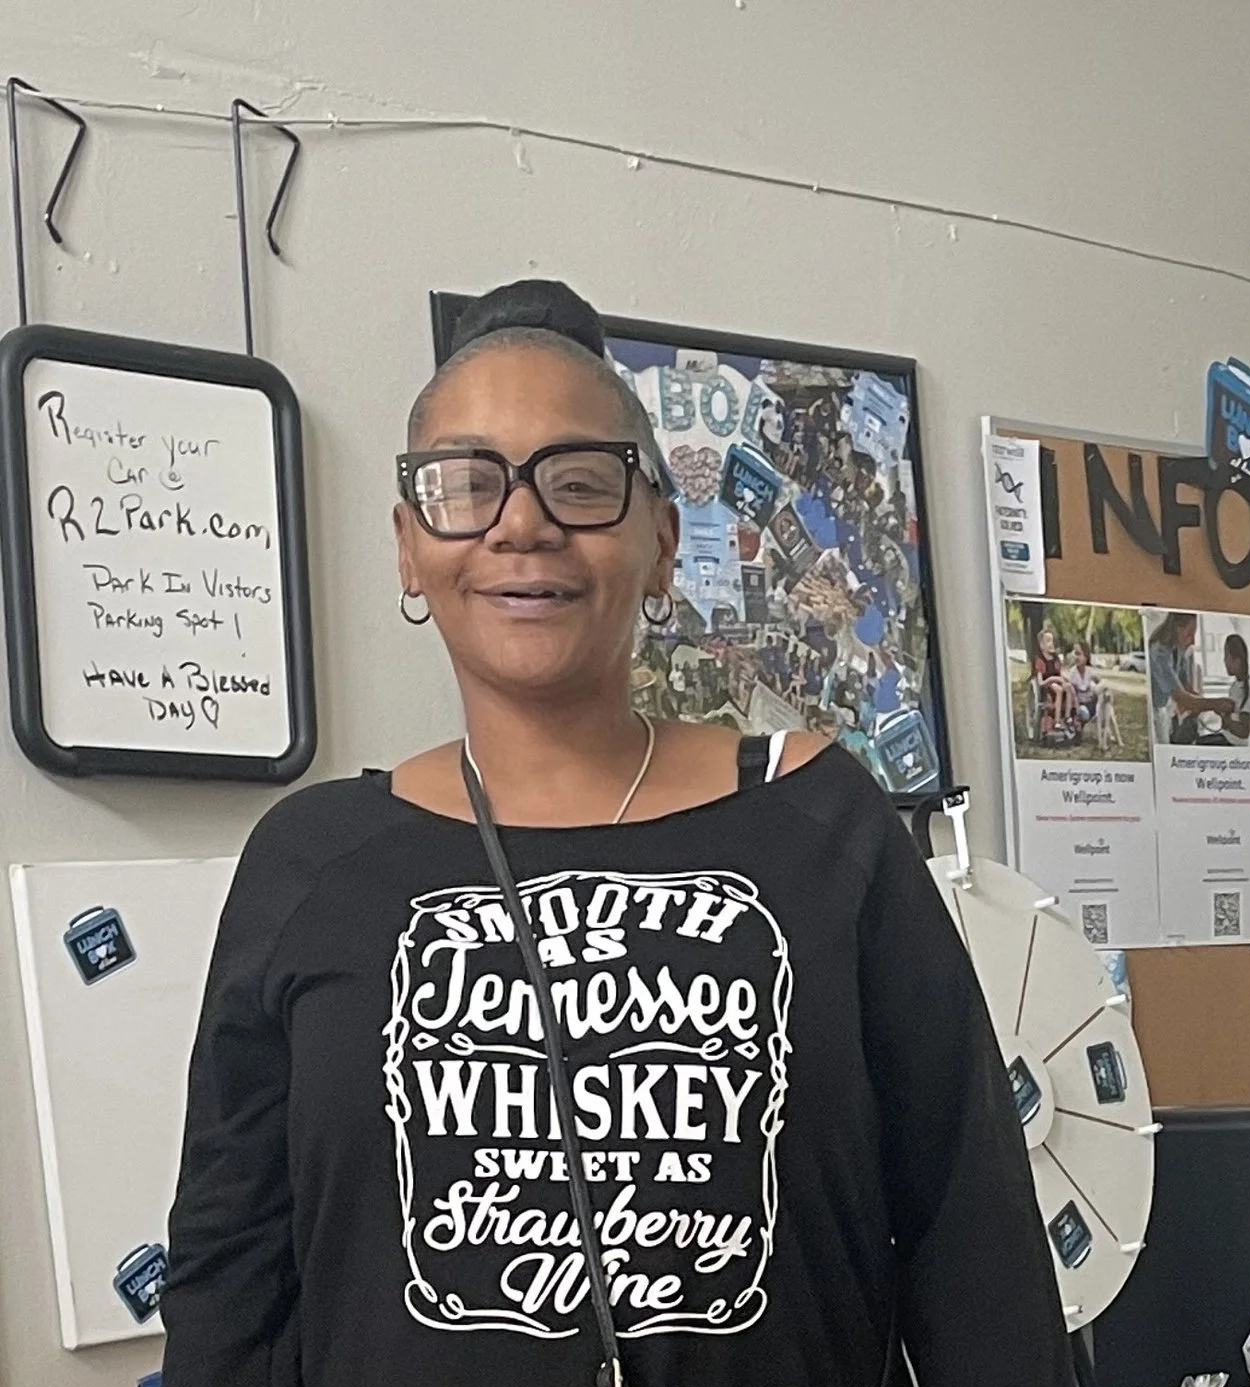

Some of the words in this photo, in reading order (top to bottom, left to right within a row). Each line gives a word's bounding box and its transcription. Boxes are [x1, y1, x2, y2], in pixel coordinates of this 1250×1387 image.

[38, 391, 146, 447] Register
[161, 434, 220, 467] your
[107, 457, 148, 484] Car
[83, 564, 154, 594] Park
[202, 568, 271, 604] Vistors
[87, 601, 163, 638] Parking
[162, 665, 175, 688] A
[179, 661, 270, 696] Blessed
[1041, 769, 1102, 785] Amerigroup
[1170, 756, 1227, 772] Amerigroup
[538, 930, 628, 967] AS
[412, 939, 758, 1041] Tennessee
[413, 1059, 762, 1143] WHISKEY
[474, 1149, 640, 1181] SWEET
[654, 1151, 712, 1183] AS
[500, 1250, 684, 1314] Wine
